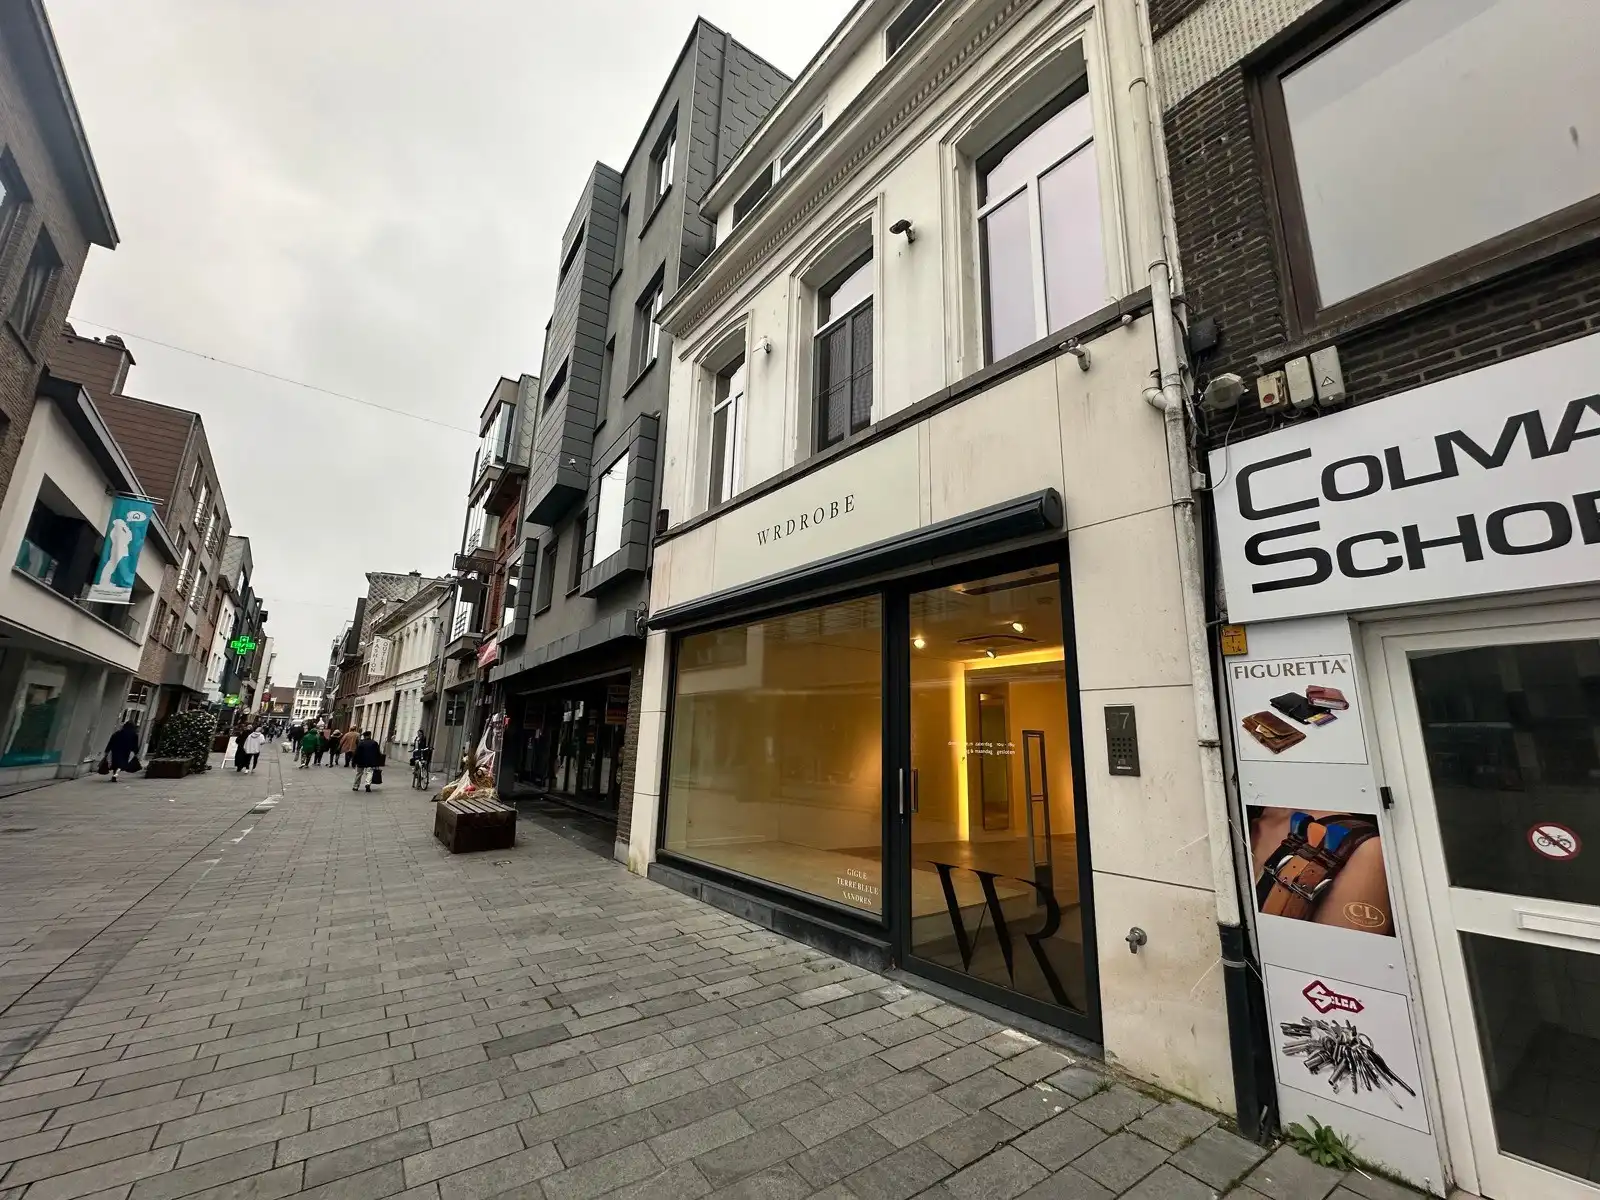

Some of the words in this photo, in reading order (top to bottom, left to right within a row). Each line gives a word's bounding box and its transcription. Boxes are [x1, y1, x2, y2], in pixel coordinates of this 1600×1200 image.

[757, 494, 855, 546] WRDROBE
[370, 638, 381, 673] FASHION
[379, 641, 388, 672] OUTLET
[1234, 659, 1346, 679] FIGURETTA
[847, 868, 868, 880] GIGUE
[837, 877, 857, 889] TERRE
[857, 882, 879, 896] BLEUE
[1349, 904, 1378, 920] CL
